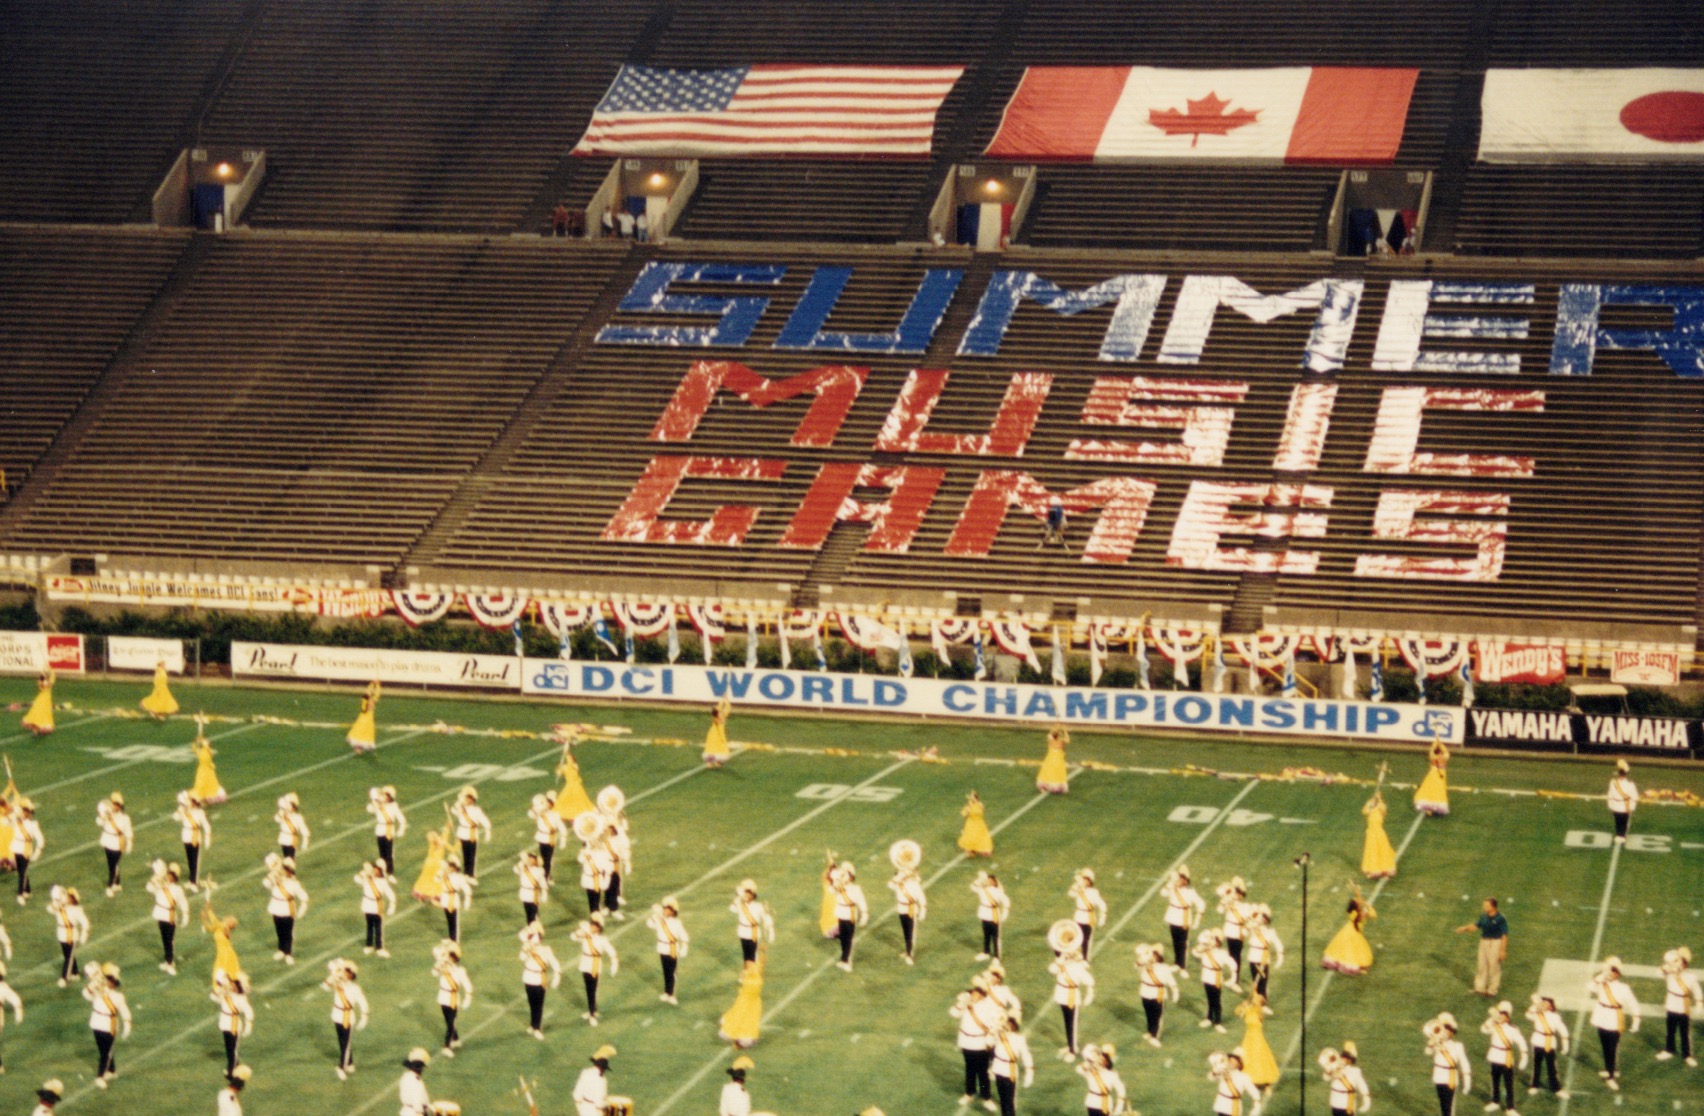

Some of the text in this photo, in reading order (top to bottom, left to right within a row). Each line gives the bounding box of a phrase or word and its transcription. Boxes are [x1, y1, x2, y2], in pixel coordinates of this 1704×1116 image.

[593, 261, 1704, 378] SUMMER
[650, 360, 1547, 477] MUSIC
[601, 455, 1512, 583] GAMES
[127, 581, 162, 599] Jugle
[249, 646, 298, 671] Pearl
[460, 657, 510, 681] Pearl
[582, 666, 674, 695] DCI
[706, 670, 908, 708] WORLD
[942, 684, 1402, 735] CHAMPIONSHIP
[1471, 710, 1573, 743] YAMAHA
[1585, 714, 1690, 750] YAMAHA
